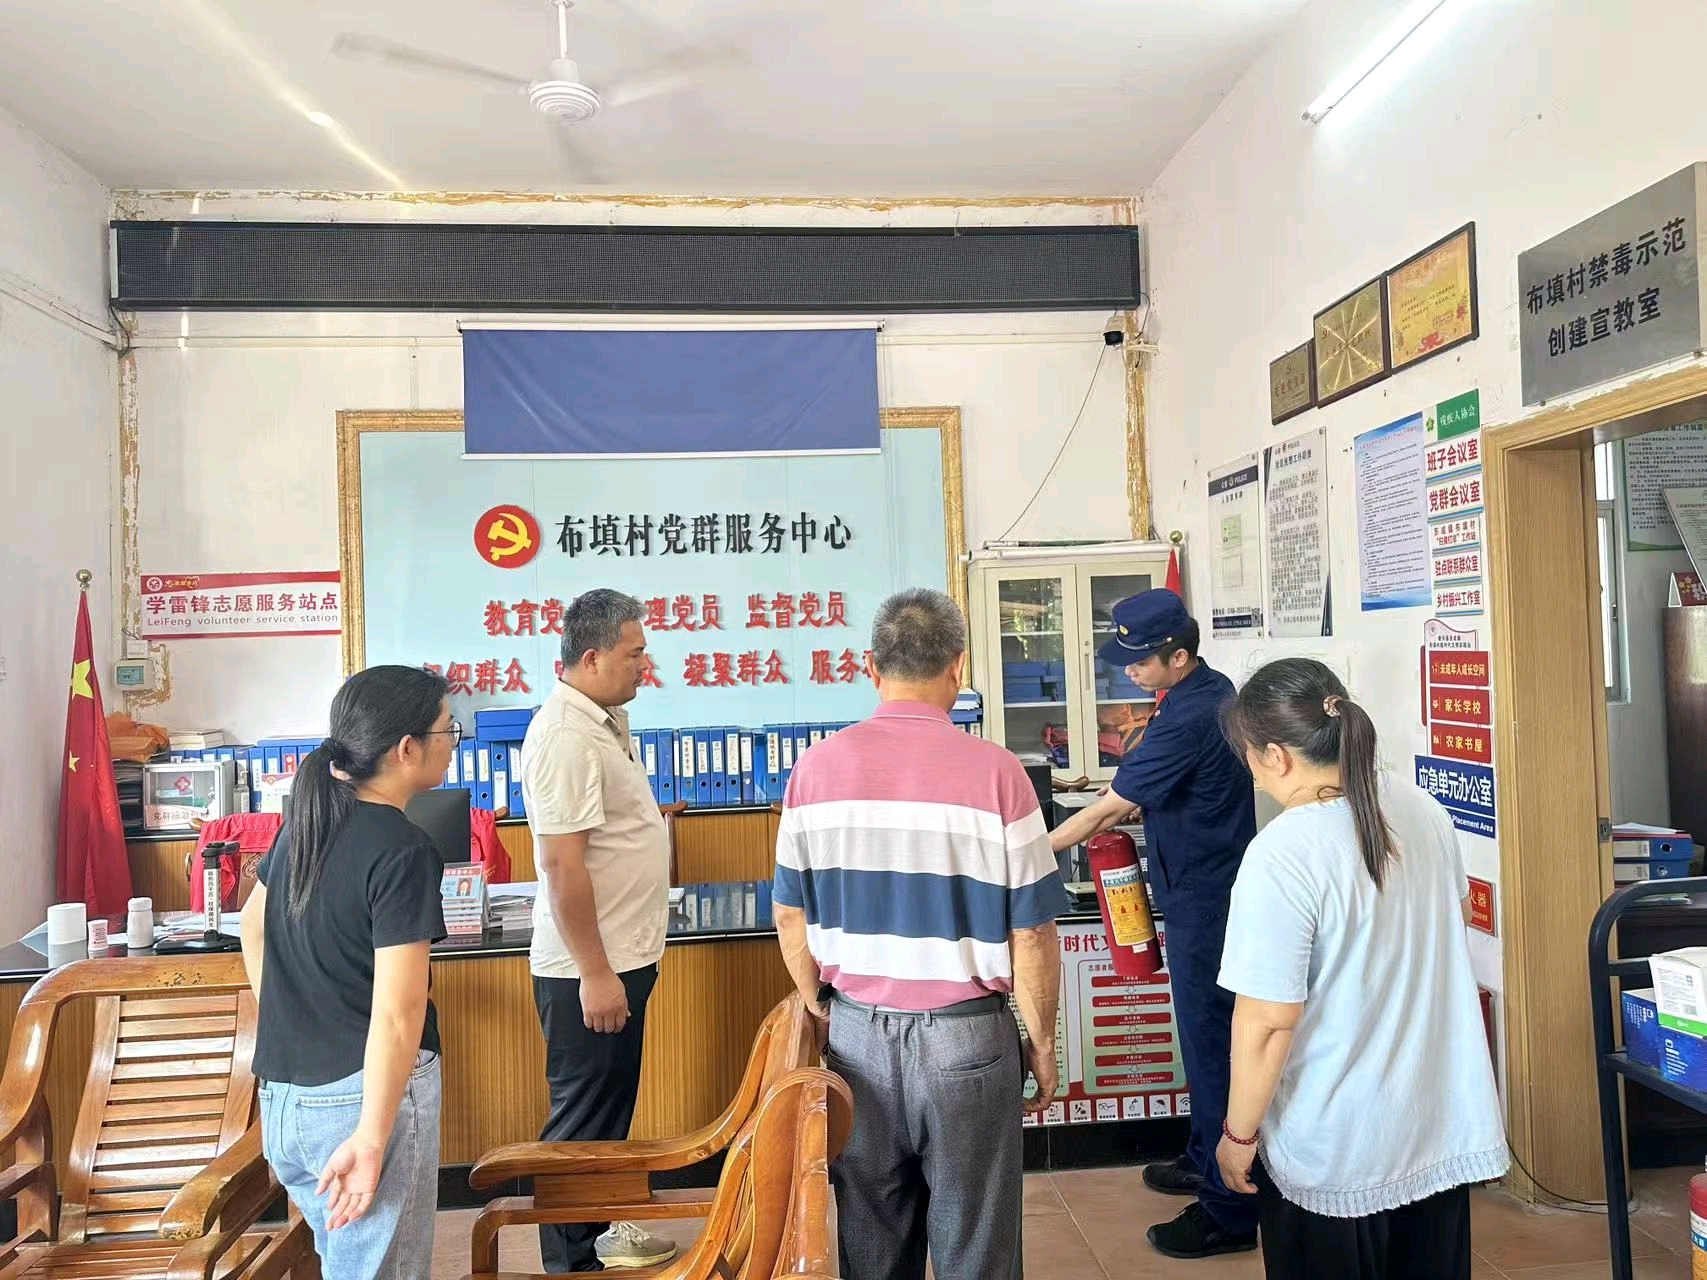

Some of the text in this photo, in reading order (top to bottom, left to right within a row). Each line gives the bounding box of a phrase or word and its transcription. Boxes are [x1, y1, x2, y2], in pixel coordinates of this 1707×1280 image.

[1526, 217, 1686, 315] 布填村禁毒示范
[1547, 287, 1661, 357] 创建宣教室
[1427, 438, 1479, 472] 班子会议室
[1429, 480, 1481, 513] 党群会议室
[554, 511, 852, 558] 布填村党群服务中心
[146, 592, 338, 614] 学雷锋志愿服务站点
[745, 590, 849, 629] 监督党员
[1436, 590, 1481, 608] 乡村振兴工作室
[147, 613, 338, 627] LeiFeng volunteer service station
[683, 648, 790, 688] 凝聚群众
[1439, 663, 1485, 677] 未成年人成长空间
[1444, 699, 1482, 714] 家长学校
[1445, 735, 1483, 752] 农家书屋
[1418, 765, 1493, 807] 应急单元办公室
[1480, 822, 1494, 833] Area
